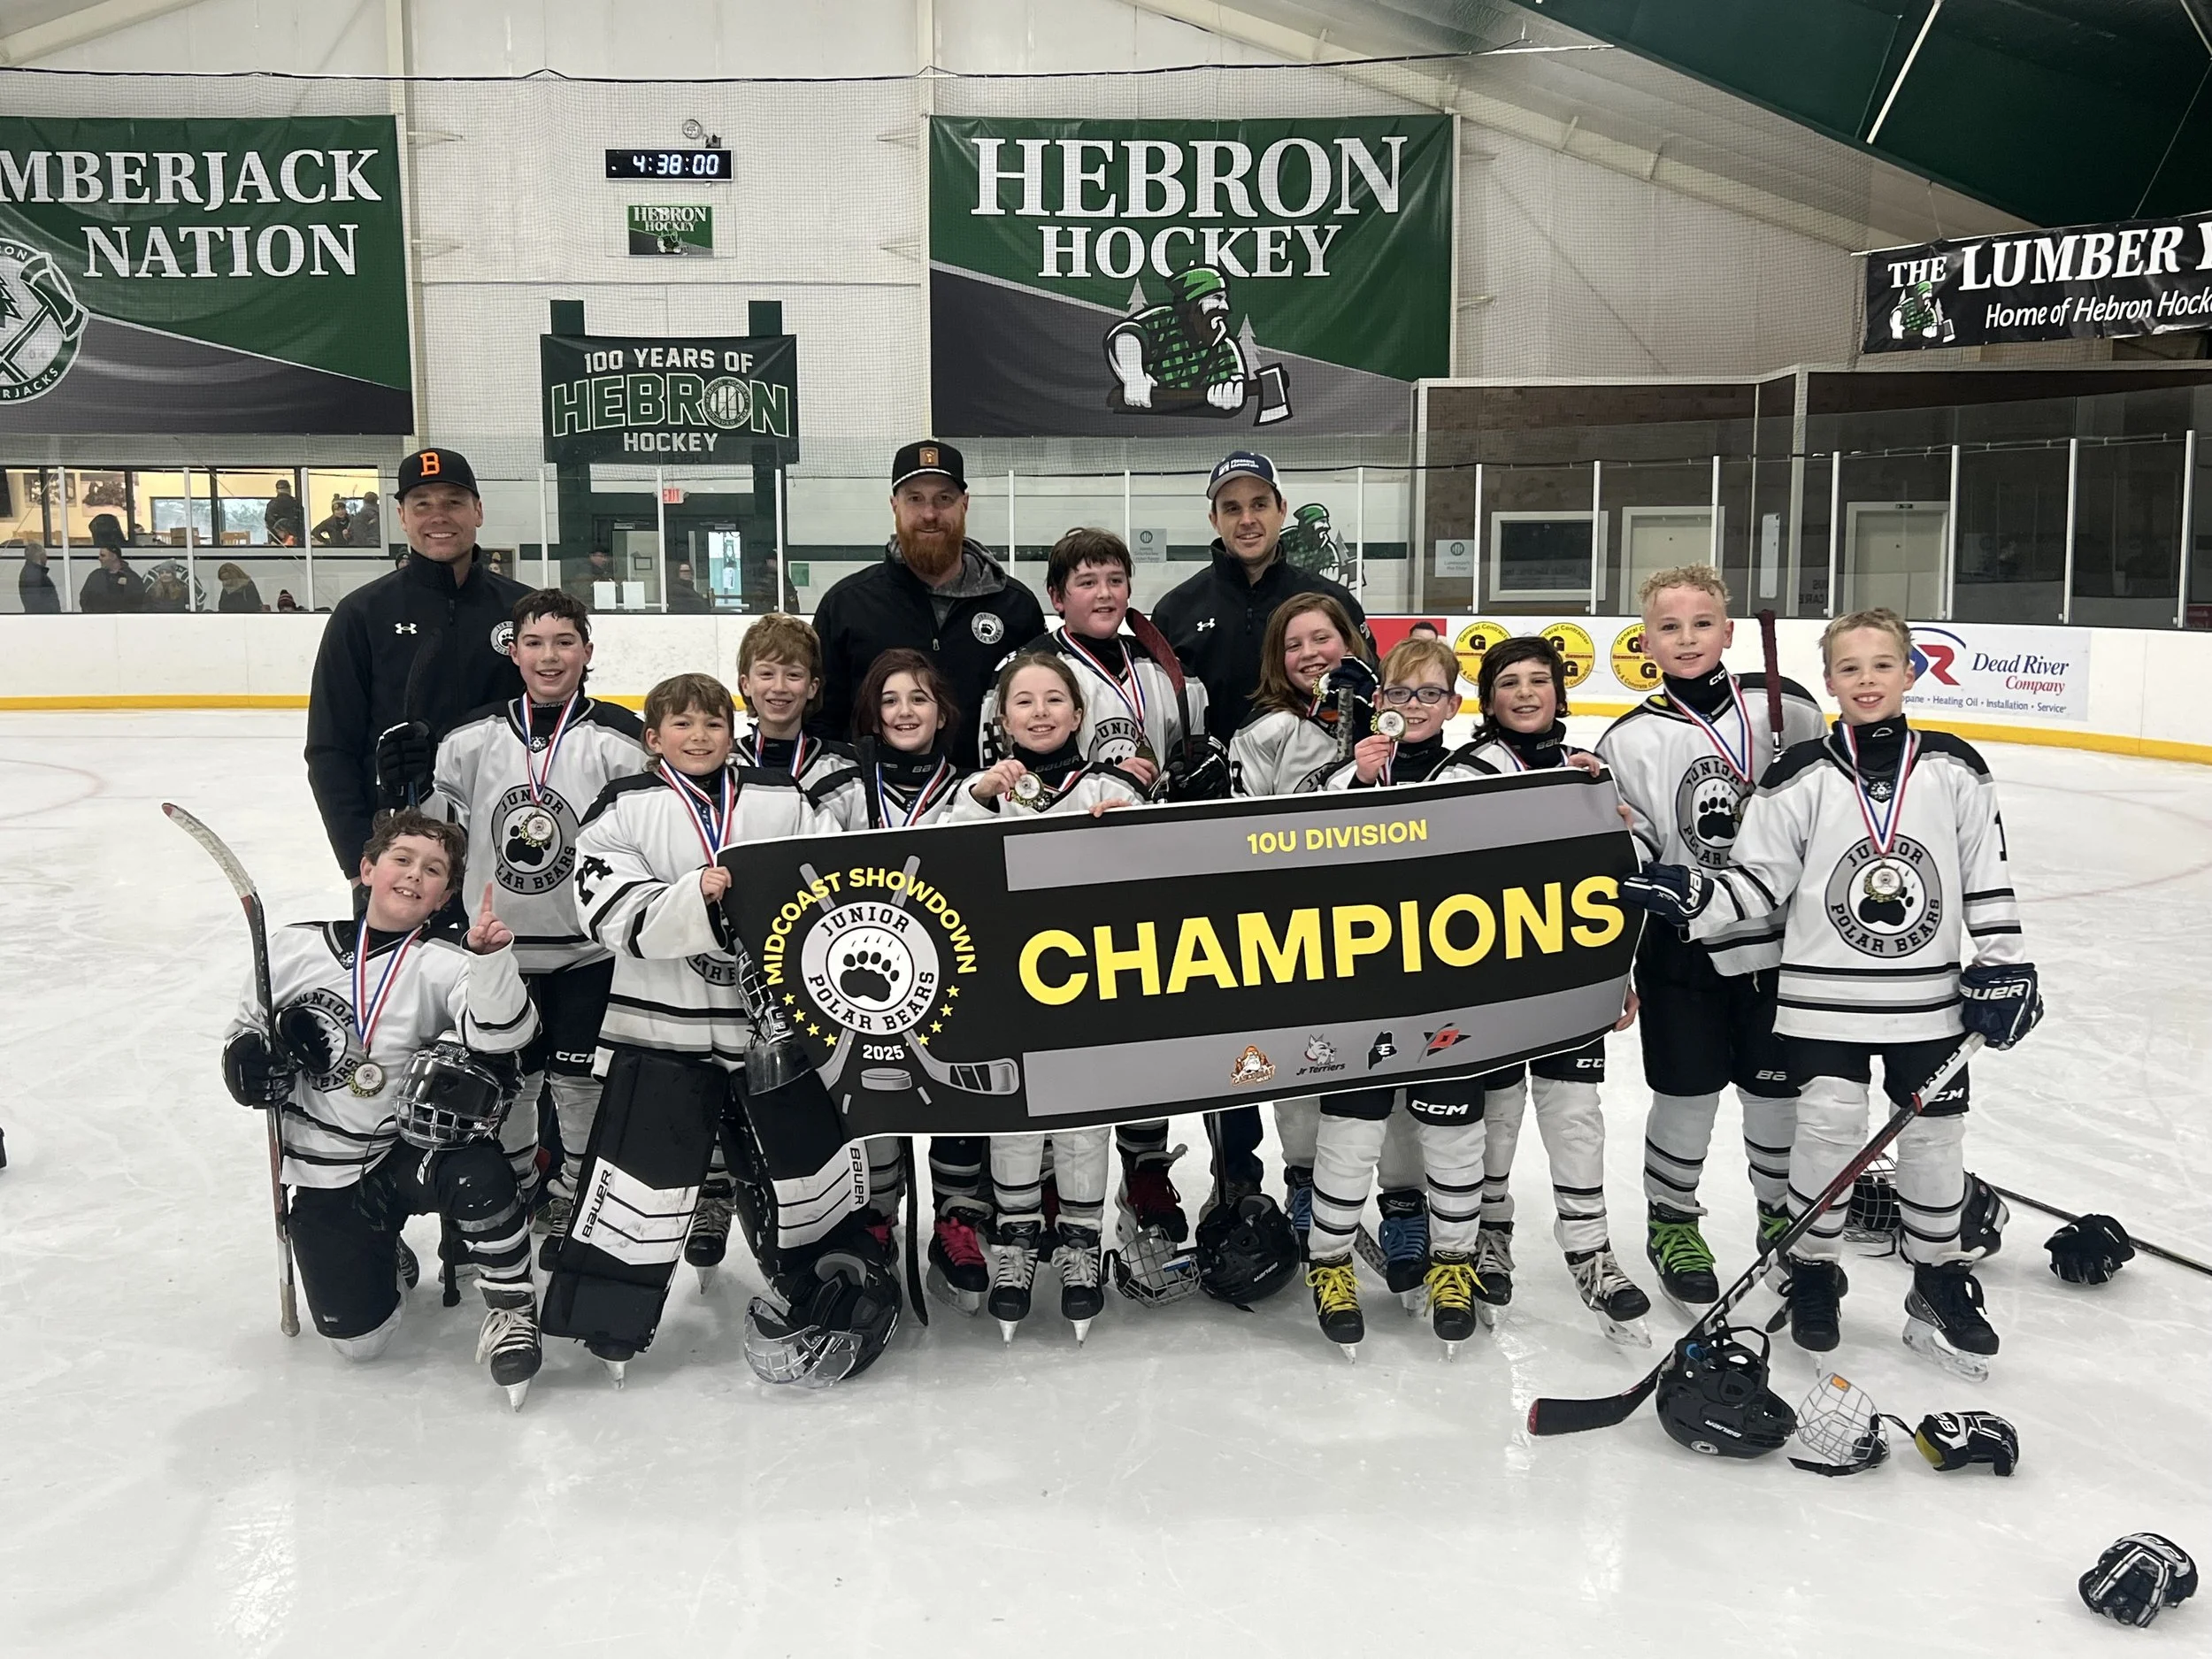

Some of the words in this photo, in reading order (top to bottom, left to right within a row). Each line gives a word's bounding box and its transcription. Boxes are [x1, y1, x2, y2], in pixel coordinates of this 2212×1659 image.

[633, 154, 719, 175] 4:38:00
[971, 136, 1409, 219] HEBRON
[0, 149, 382, 211] MBERJACK
[634, 206, 707, 222] HEBRON
[645, 221, 695, 233] HOCKEY
[81, 223, 359, 279] NATION
[1037, 225, 1343, 280] HOCKEY
[1887, 256, 1947, 288] THE
[1958, 225, 2185, 292] LUMBER
[1985, 303, 2045, 329] Home
[2050, 296, 2073, 326] of
[2073, 295, 2153, 323] Hebron
[2156, 287, 2212, 318] Hock
[585, 349, 624, 373] 100
[634, 348, 715, 369] YEARS
[724, 352, 754, 374] OF
[551, 373, 789, 438] HEBRON
[623, 433, 718, 452] HOCKEY
[419, 451, 441, 477] B
[1482, 624, 1508, 640] Contract
[1544, 626, 1559, 637] neral
[1972, 653, 2021, 673] Dead
[2024, 655, 2069, 675] River
[1709, 672, 1725, 686] CC
[2005, 675, 2065, 696] Company
[1932, 696, 1963, 708] Heating
[1966, 697, 1978, 707] Oil
[1986, 700, 2029, 710] Installation
[1096, 722, 1136, 740] UNIO
[1536, 737, 1562, 750] BAU
[502, 789, 564, 815] JUNOR
[1246, 830, 1297, 856] 10U
[1306, 819, 1428, 851] DIVISION
[1847, 841, 1923, 867] JUOR
[495, 862, 524, 889] LAR
[533, 846, 576, 889] BEARS
[764, 872, 841, 987] MIDCOAST
[849, 867, 977, 974] SHOWDOWN
[821, 906, 910, 937] JUNIOR
[1831, 902, 1885, 953] POLAR
[1894, 898, 1939, 952] BEARS
[1018, 876, 1625, 1006] CHAMPIONS
[808, 974, 872, 1030] POLAR
[885, 971, 935, 1030] BEARS
[1960, 983, 2024, 1002] AUER
[863, 1044, 905, 1061] 2025
[1576, 1057, 1605, 1069] CC
[1296, 1067, 1307, 1076] Jr
[1309, 1063, 1346, 1075] Terriers
[1411, 1099, 1469, 1116] CCM
[849, 1147, 864, 1206] BAUER
[582, 1169, 612, 1239] BAUER
[1704, 1419, 1742, 1438] BAUER
